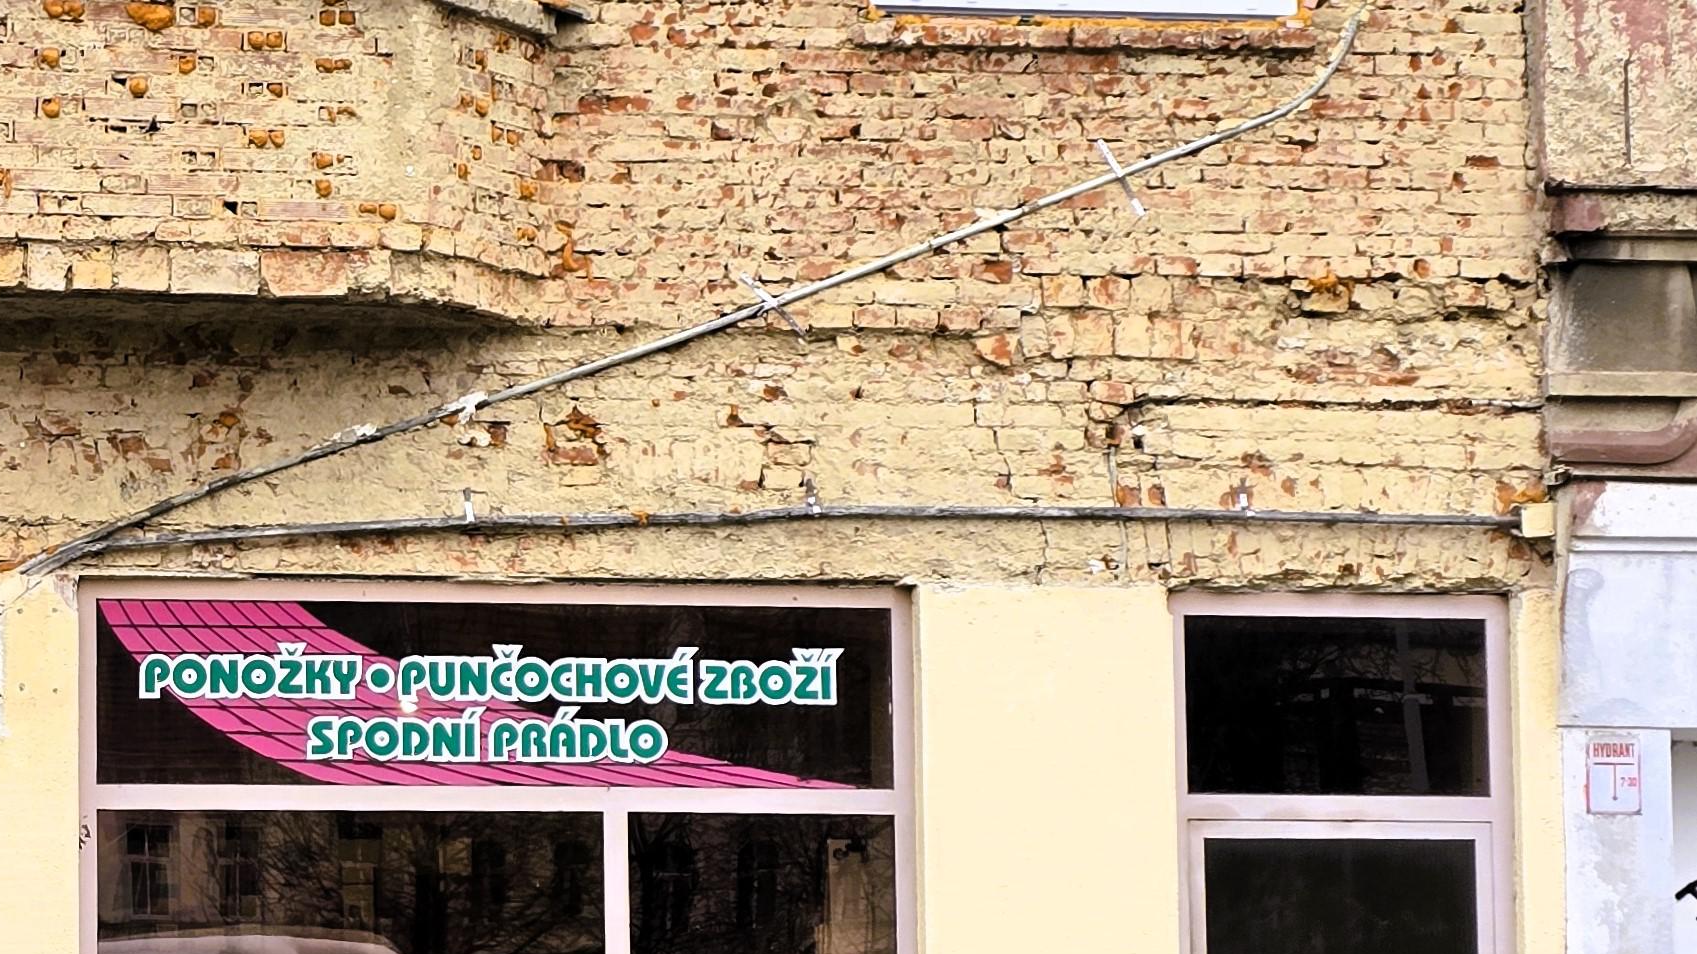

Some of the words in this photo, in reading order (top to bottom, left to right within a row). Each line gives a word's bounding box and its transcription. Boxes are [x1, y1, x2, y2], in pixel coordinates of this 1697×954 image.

[139, 643, 362, 699] PONOŽKY
[398, 645, 698, 704] PUNČOCHOVÉ
[699, 648, 844, 705] ZBOŽÍ
[306, 706, 486, 761] SPODNÍ
[487, 706, 668, 763] PRÁDLO
[1593, 743, 1635, 757] HYDRANT
